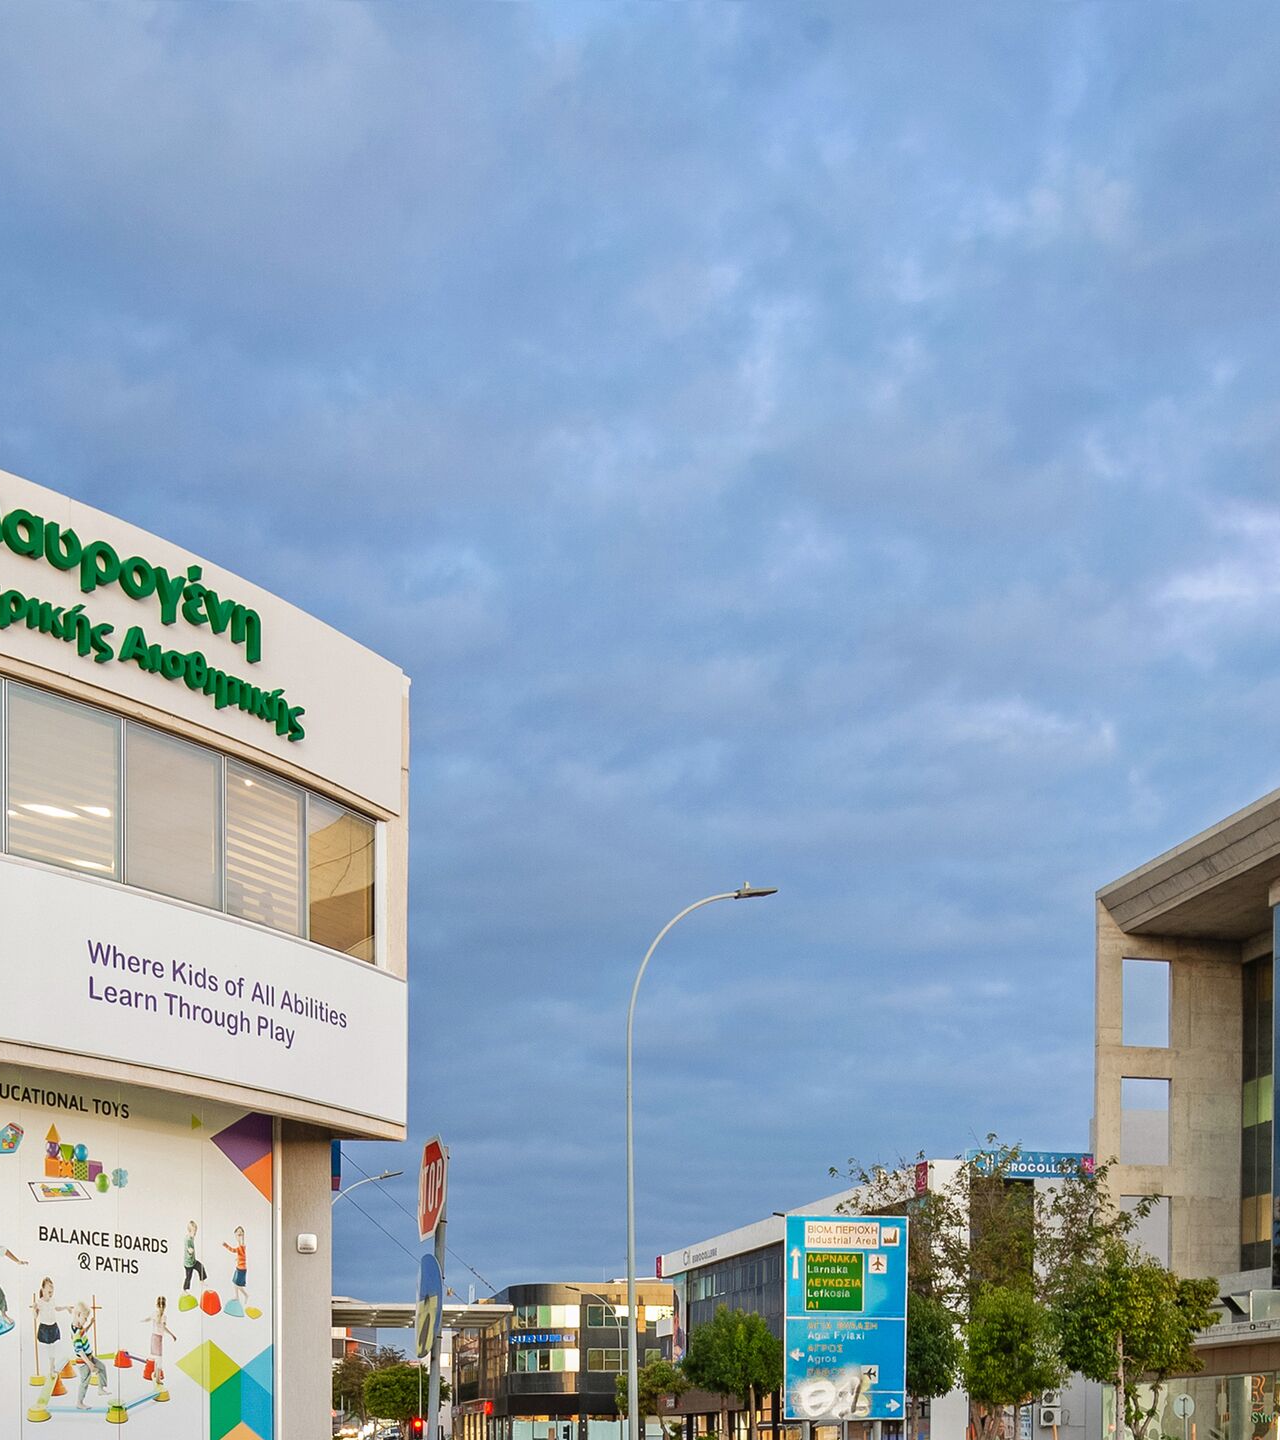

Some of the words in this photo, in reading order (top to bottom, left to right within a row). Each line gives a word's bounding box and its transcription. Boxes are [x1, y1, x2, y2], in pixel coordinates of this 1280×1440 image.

[118, 625, 307, 743] Αισθητικής
[87, 940, 165, 978] Where
[172, 960, 218, 992] Kids
[225, 973, 245, 999] of
[251, 982, 276, 1008] All
[280, 990, 348, 1029] Abilities
[88, 976, 157, 1012] Learn
[164, 995, 251, 1037] Through
[257, 1016, 296, 1050] Play
[93, 1098, 130, 1119] TOYS
[836, 1226, 878, 1235] ΠΕΡΙΟΧΗ
[38, 1225, 110, 1248] BALANCE
[114, 1233, 169, 1254] BOARDS
[808, 1235, 852, 1244] Industrial
[855, 1237, 877, 1245] Area
[77, 1251, 91, 1271] &
[95, 1256, 139, 1274] PATHS
[808, 1254, 858, 1264] ΛΑΡΝΑΚΑ
[807, 1265, 848, 1274] Larnaka
[807, 1289, 851, 1298] Lefkosia
[808, 1355, 837, 1364] Agros
